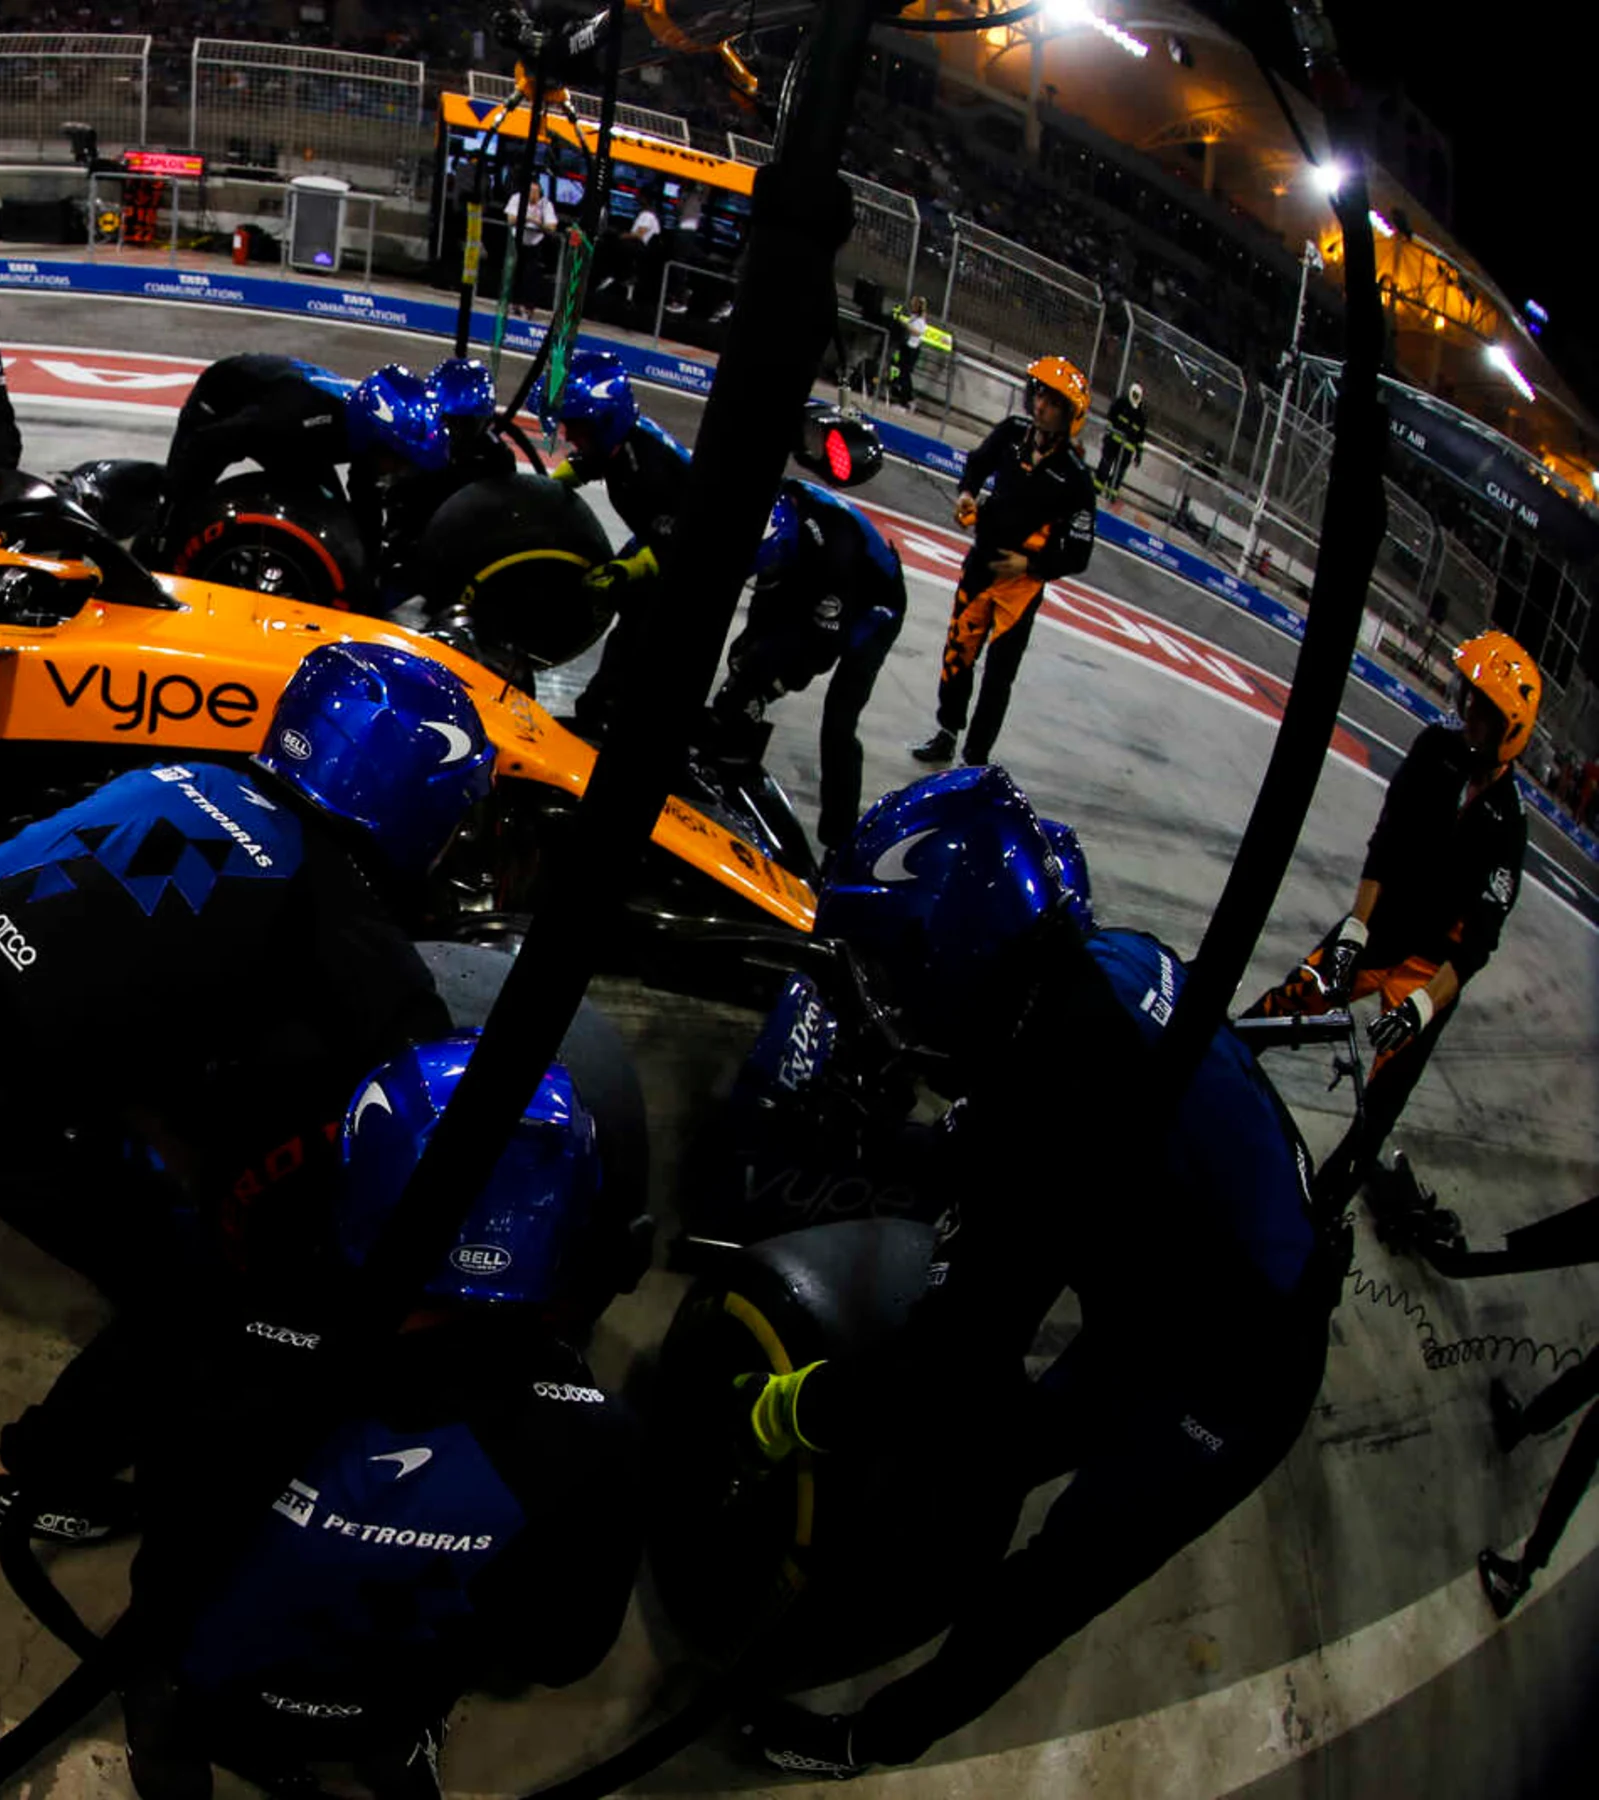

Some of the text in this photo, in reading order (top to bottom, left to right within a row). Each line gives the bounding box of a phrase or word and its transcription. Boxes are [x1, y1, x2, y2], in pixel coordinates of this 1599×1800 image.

[7, 262, 38, 273] TATA
[144, 282, 244, 301] COMMUNICATIONS
[178, 274, 210, 286] TATA
[307, 299, 408, 325] COMMUNICATIONS
[342, 294, 374, 307] TATA
[679, 363, 708, 378] TATA
[1407, 427, 1428, 451] AIR
[1486, 481, 1541, 530] GULF AIR
[43, 659, 259, 735] vype
[283, 730, 309, 757] BELL
[177, 782, 274, 868] PETROBRAS
[459, 1249, 507, 1266] BELL
[321, 1512, 494, 1553] PETROBRAS
